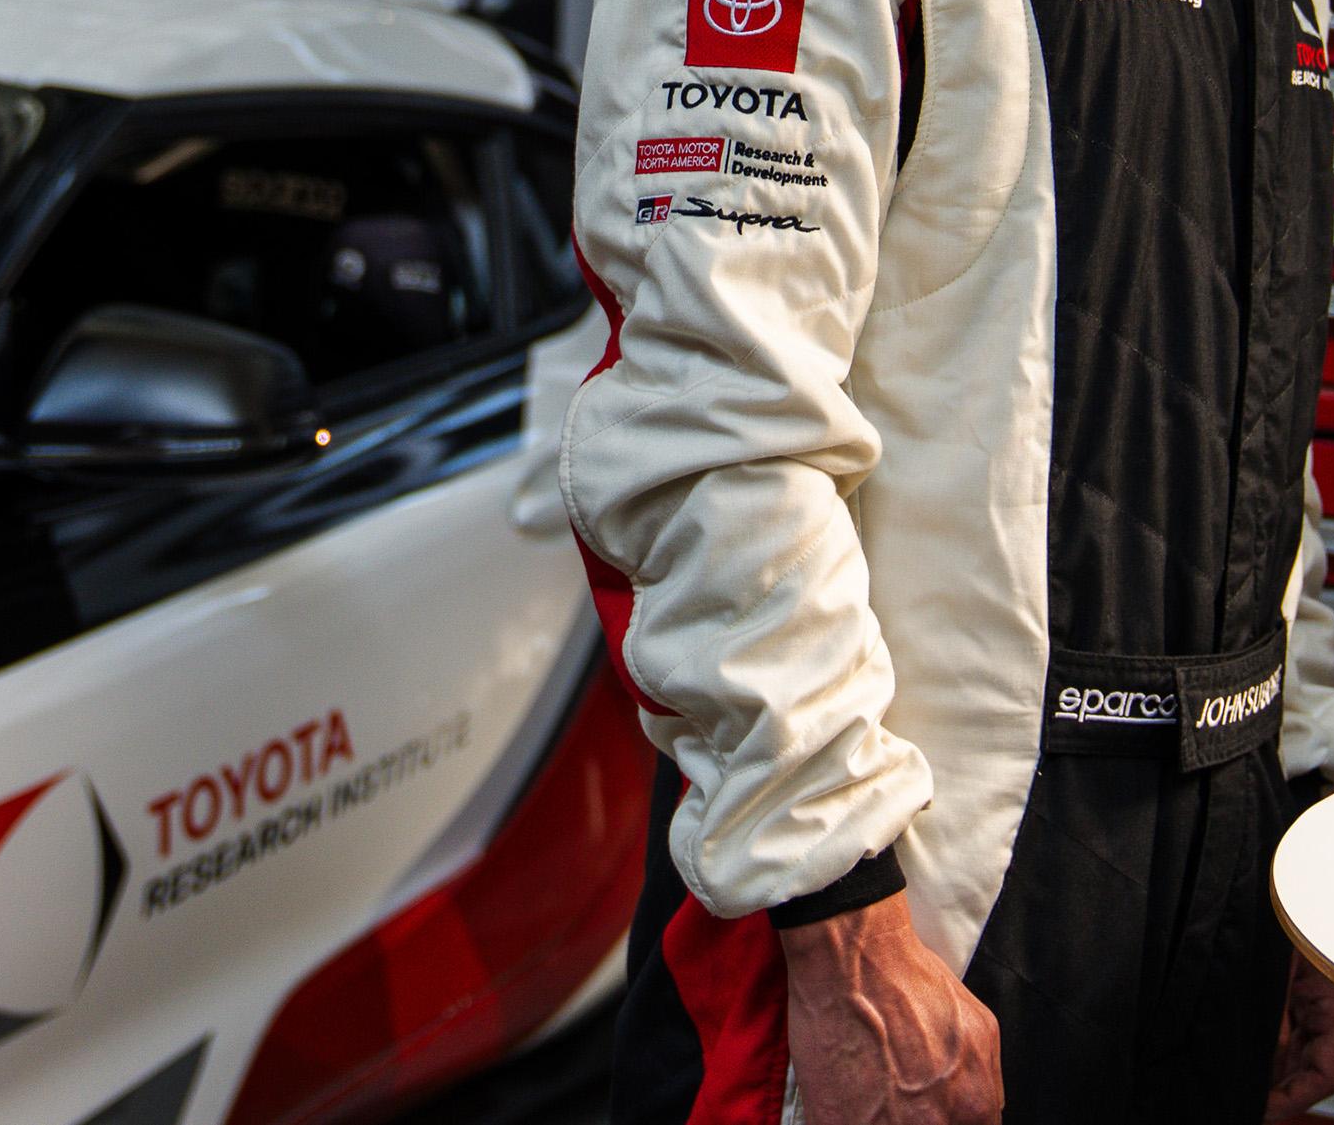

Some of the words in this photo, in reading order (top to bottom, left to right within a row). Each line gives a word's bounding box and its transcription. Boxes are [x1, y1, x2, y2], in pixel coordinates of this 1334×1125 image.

[662, 81, 808, 122] TOYOTA
[637, 156, 669, 170] NORTH
[670, 155, 717, 168] AMERICA
[638, 142, 676, 157] TOYOTA
[678, 141, 720, 155] MOTOR
[734, 141, 801, 166] Research
[803, 152, 815, 168] &
[731, 160, 829, 187] Development
[671, 197, 821, 236] Supra
[1056, 686, 1178, 724] sparco
[147, 708, 356, 859] TOYOTA
[140, 793, 324, 922] RESEARCH
